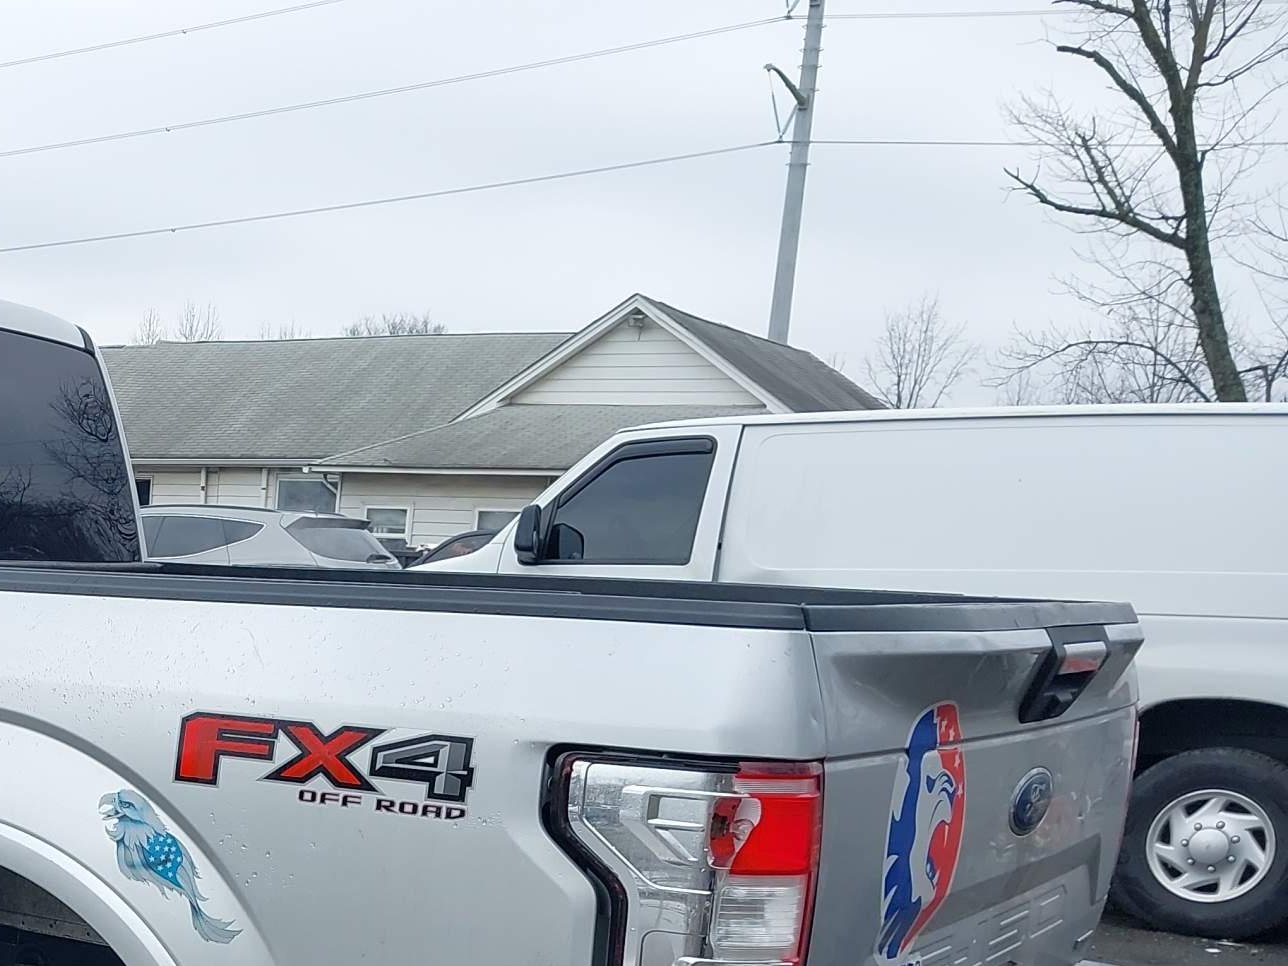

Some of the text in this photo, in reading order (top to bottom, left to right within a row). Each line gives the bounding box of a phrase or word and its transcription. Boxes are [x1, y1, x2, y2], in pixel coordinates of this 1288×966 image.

[173, 711, 476, 803] FX4
[298, 790, 467, 820] OFF ROAD
